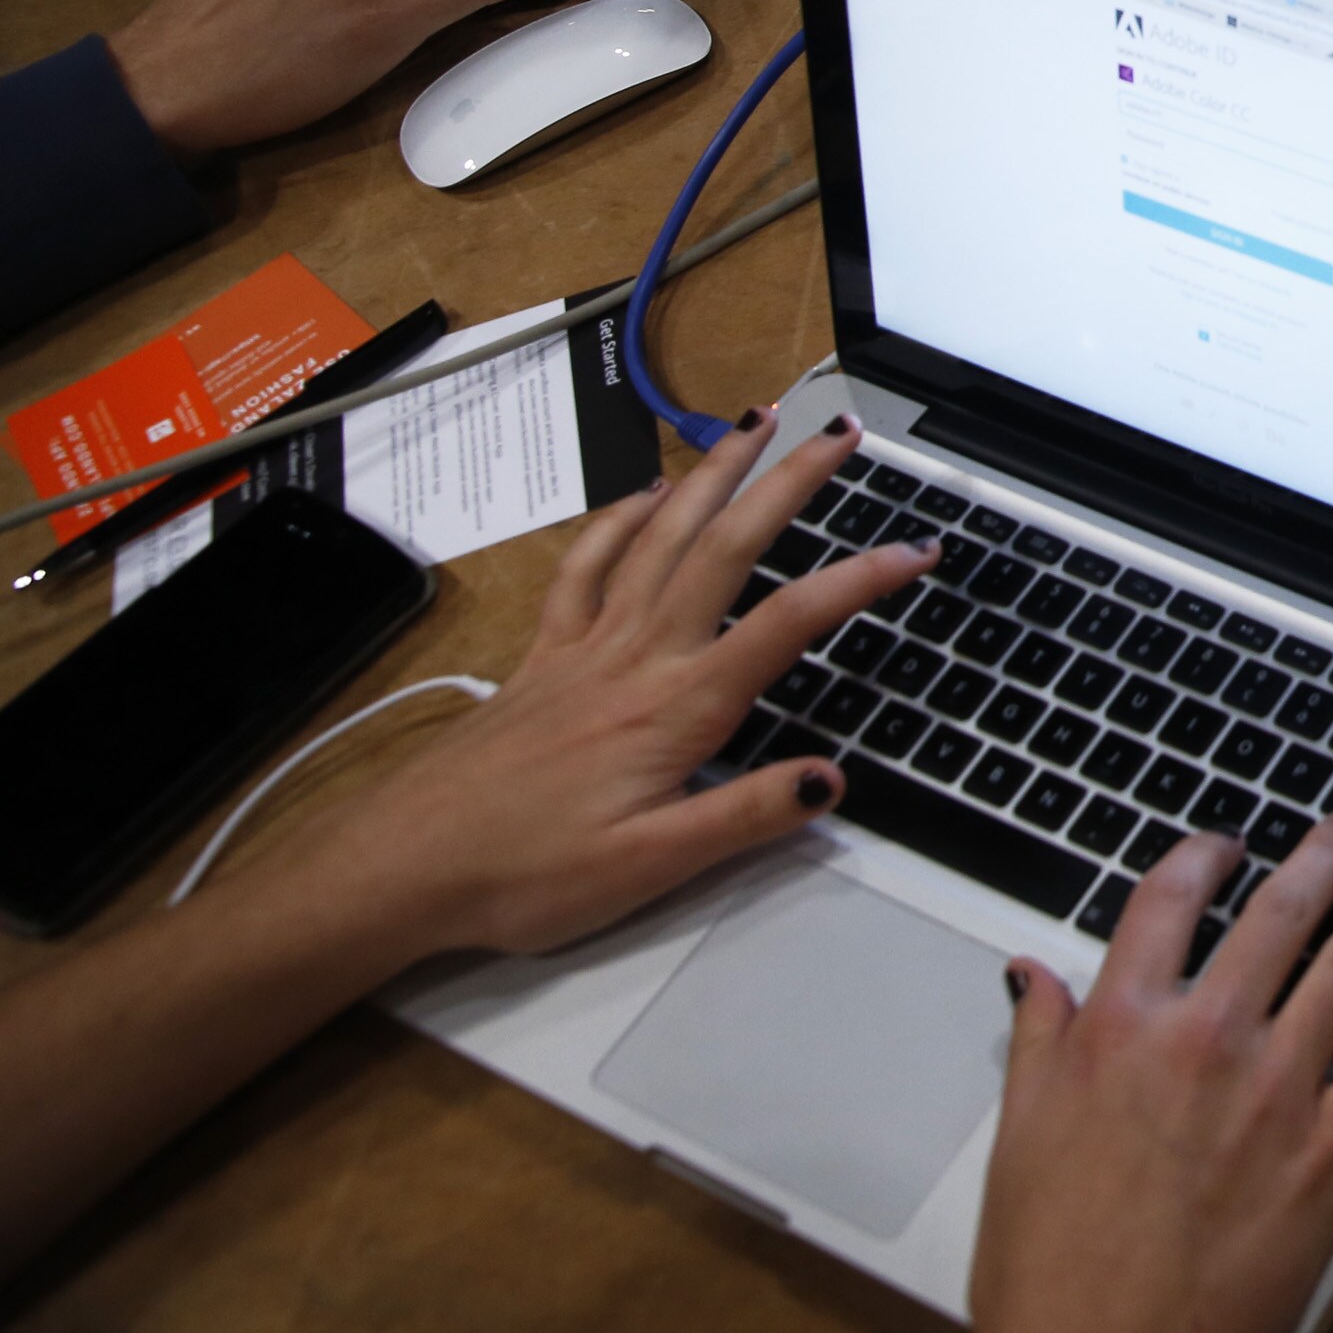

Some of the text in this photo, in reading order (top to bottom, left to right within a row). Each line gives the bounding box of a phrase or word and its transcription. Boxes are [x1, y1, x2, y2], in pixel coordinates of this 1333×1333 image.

[1150, 24, 1209, 57] Adobe
[1215, 45, 1238, 67] ID
[1142, 74, 1253, 123] Adobe Color CC
[598, 319, 622, 387] Get Started
[231, 356, 319, 419] FASHION
